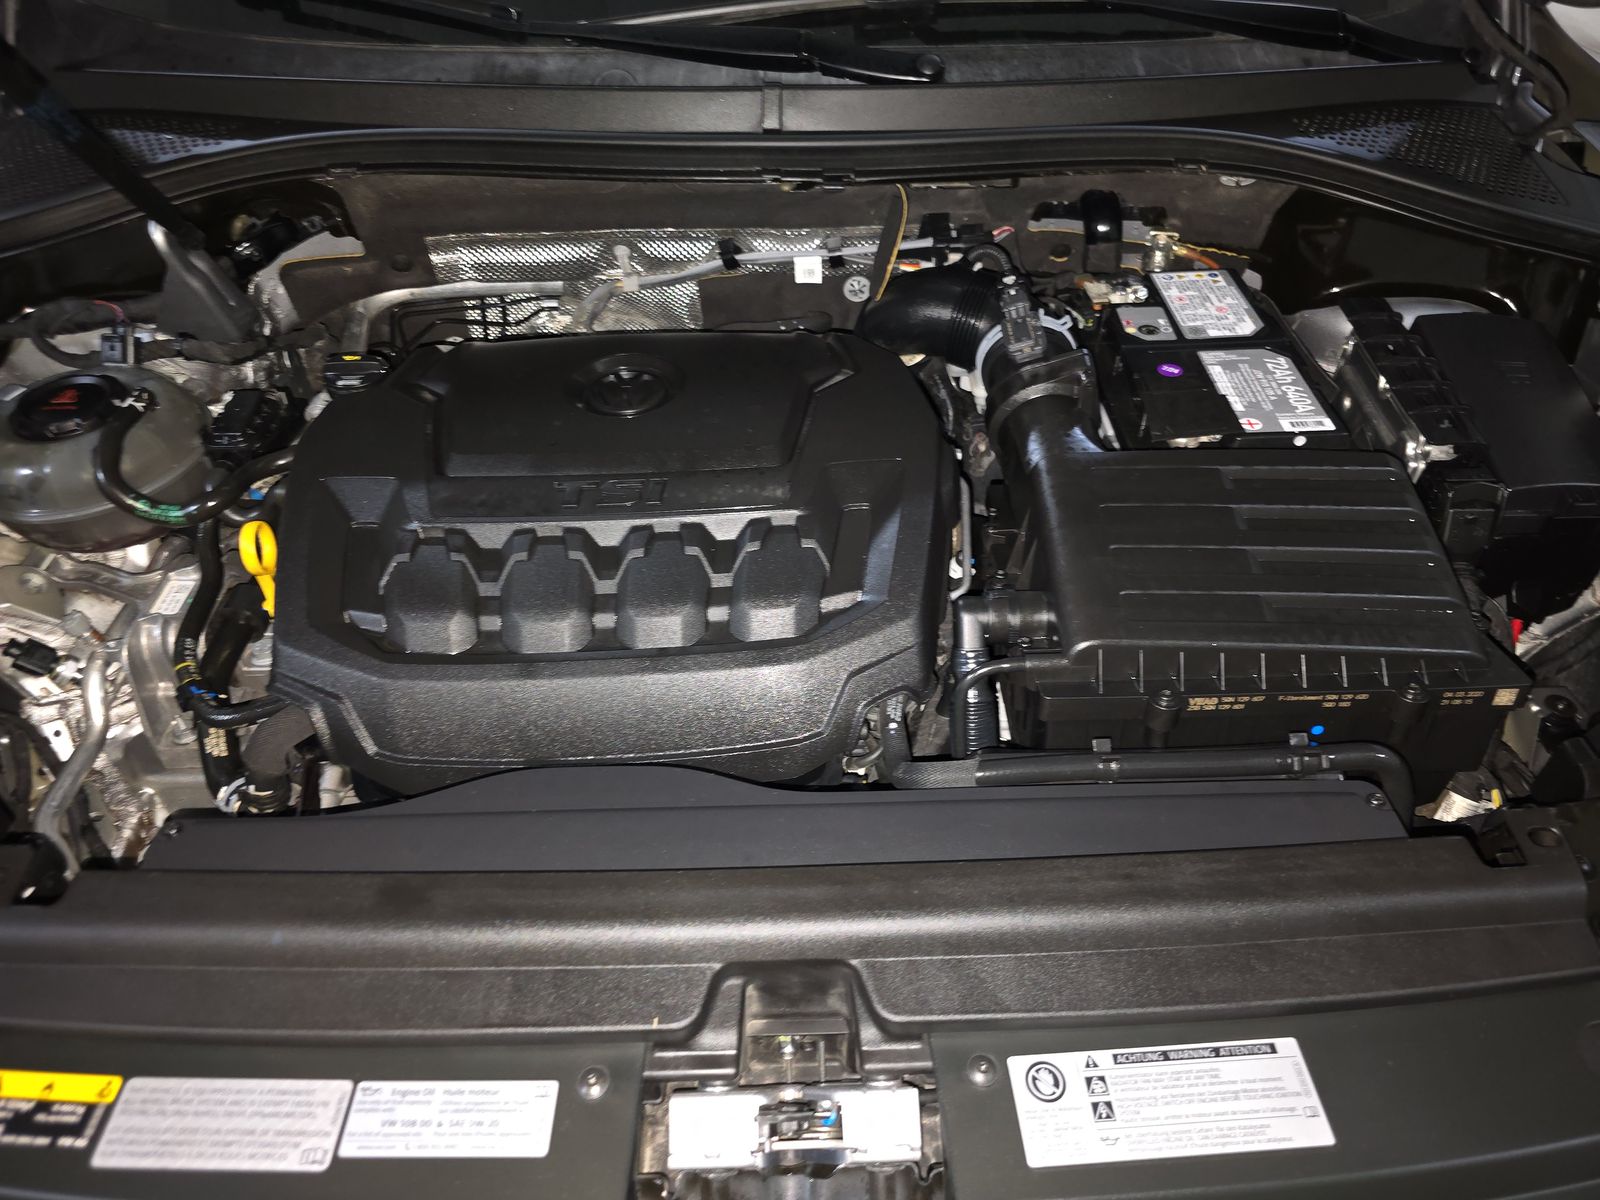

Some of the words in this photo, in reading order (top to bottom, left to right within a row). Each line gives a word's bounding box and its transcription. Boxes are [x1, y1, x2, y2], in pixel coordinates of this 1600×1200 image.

[1263, 357, 1297, 383] 72Ah
[1281, 385, 1316, 413] 640A
[553, 478, 669, 507] TSI
[1116, 1051, 1164, 1064] ACHTUNG
[1167, 1048, 1216, 1060] WARNING
[1218, 1044, 1272, 1056] ATTENTION
